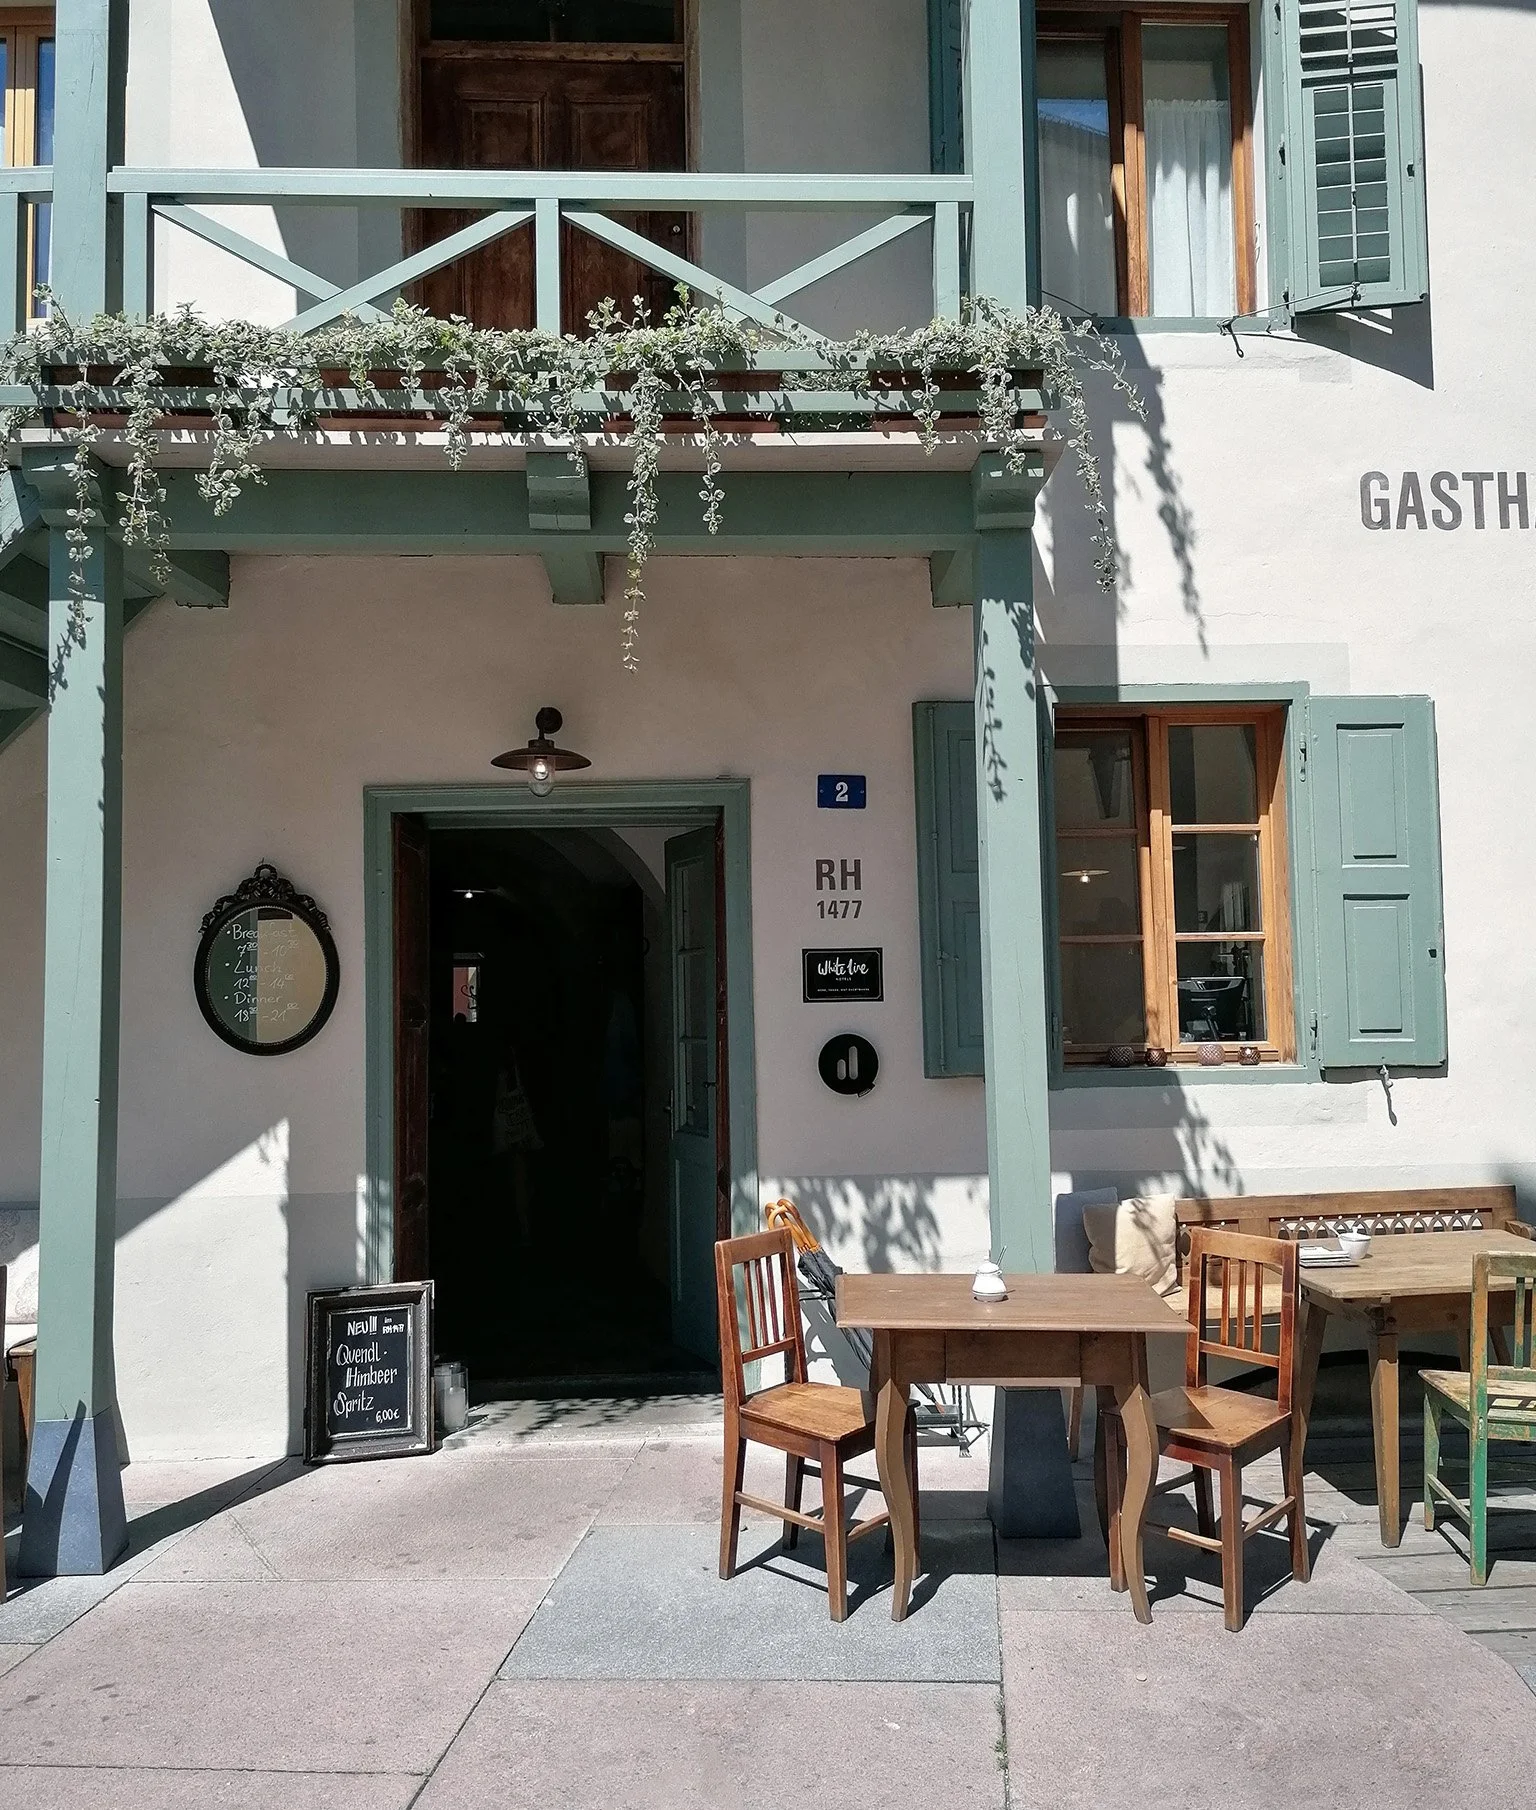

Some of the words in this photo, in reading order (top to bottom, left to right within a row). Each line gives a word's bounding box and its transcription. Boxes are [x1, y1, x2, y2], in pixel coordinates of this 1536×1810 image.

[1360, 471, 1536, 530] GASTH
[835, 782, 849, 802] 2
[815, 859, 861, 890] RH
[816, 900, 862, 919] 1477
[817, 956, 847, 976] White
[233, 991, 282, 1005] Dinner
[345, 1365, 398, 1388] Himbeer
[333, 1390, 375, 1419] Spritz
